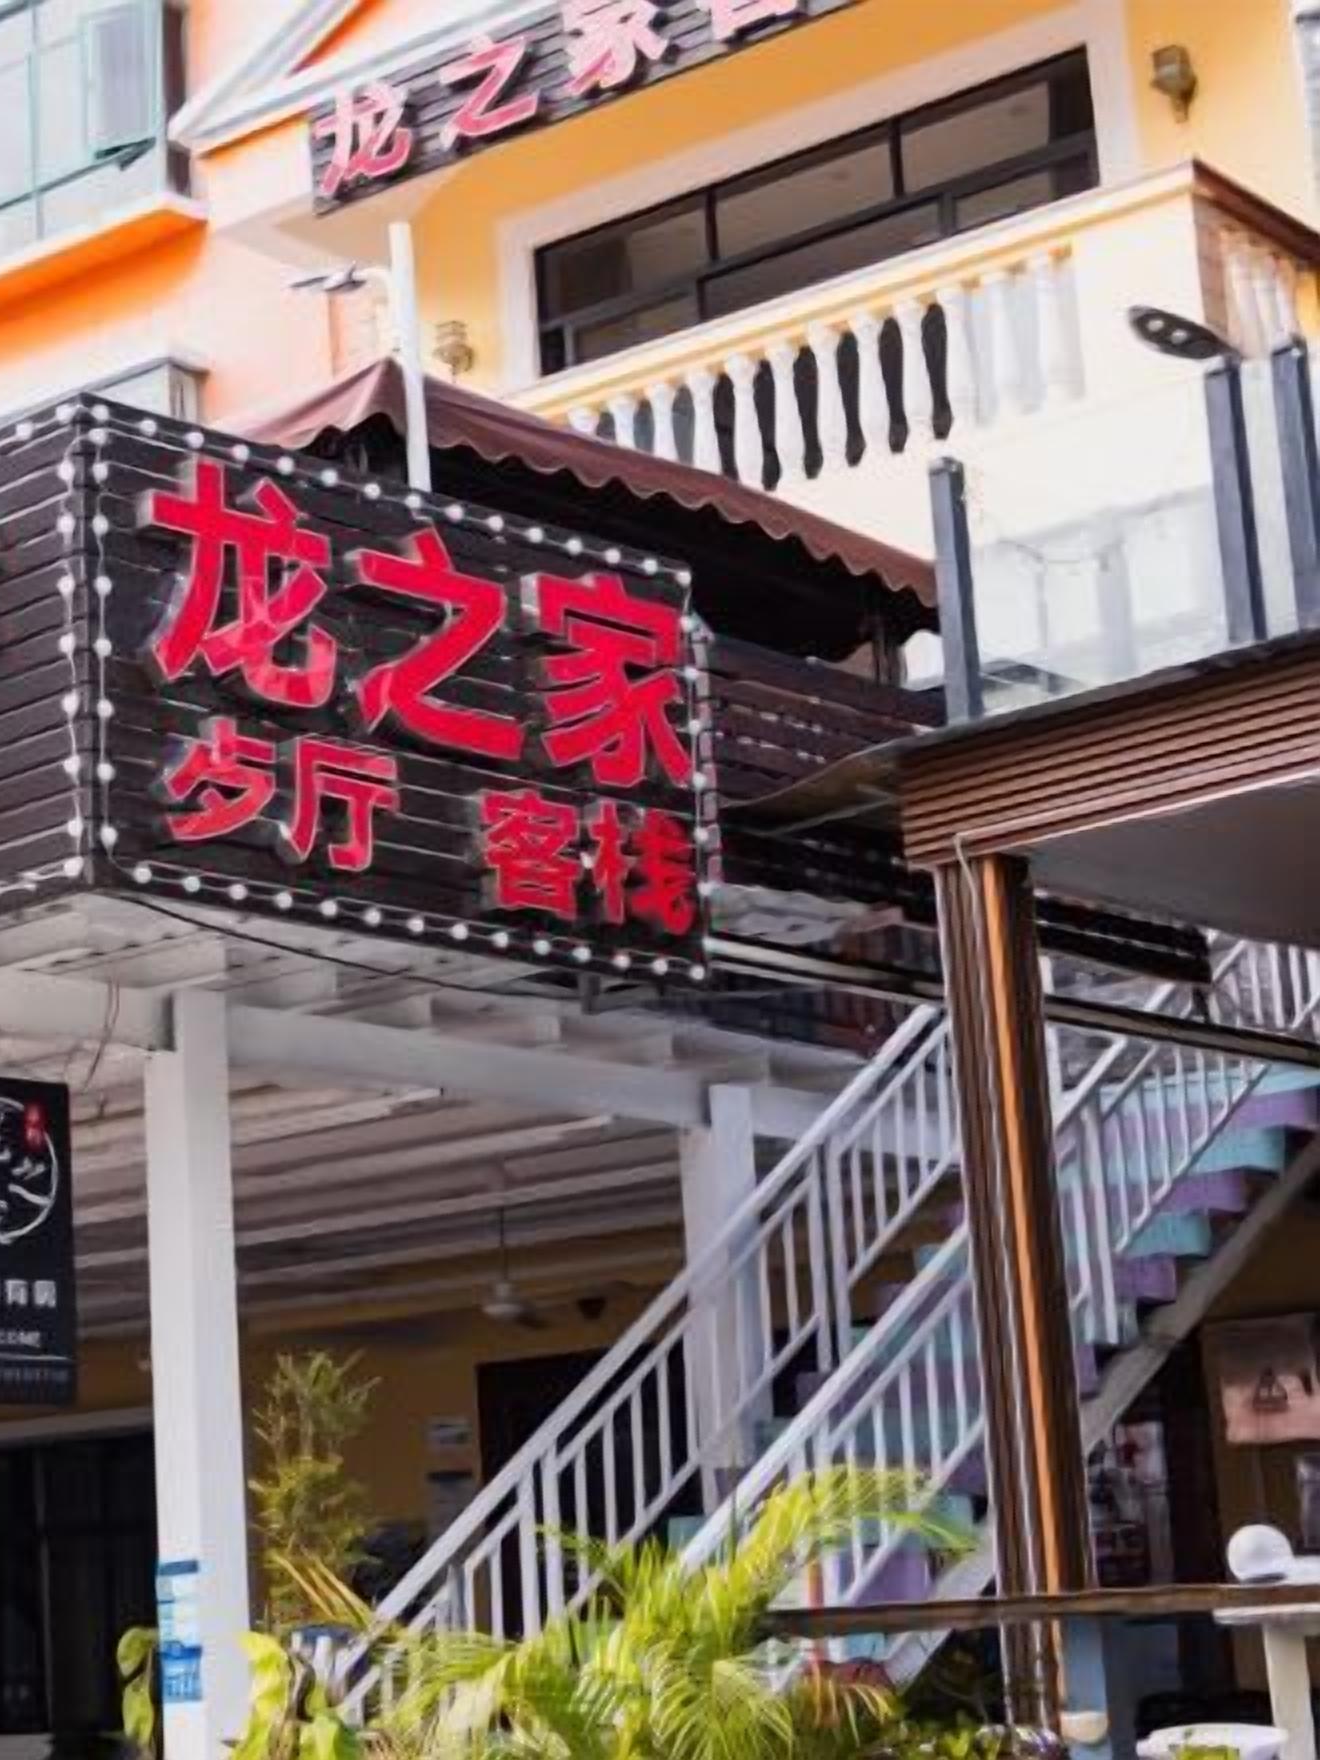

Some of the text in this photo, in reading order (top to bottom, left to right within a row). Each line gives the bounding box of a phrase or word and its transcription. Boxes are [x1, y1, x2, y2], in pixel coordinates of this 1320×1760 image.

[142, 458, 693, 788] 龙之家
[475, 788, 696, 936] 客栈
